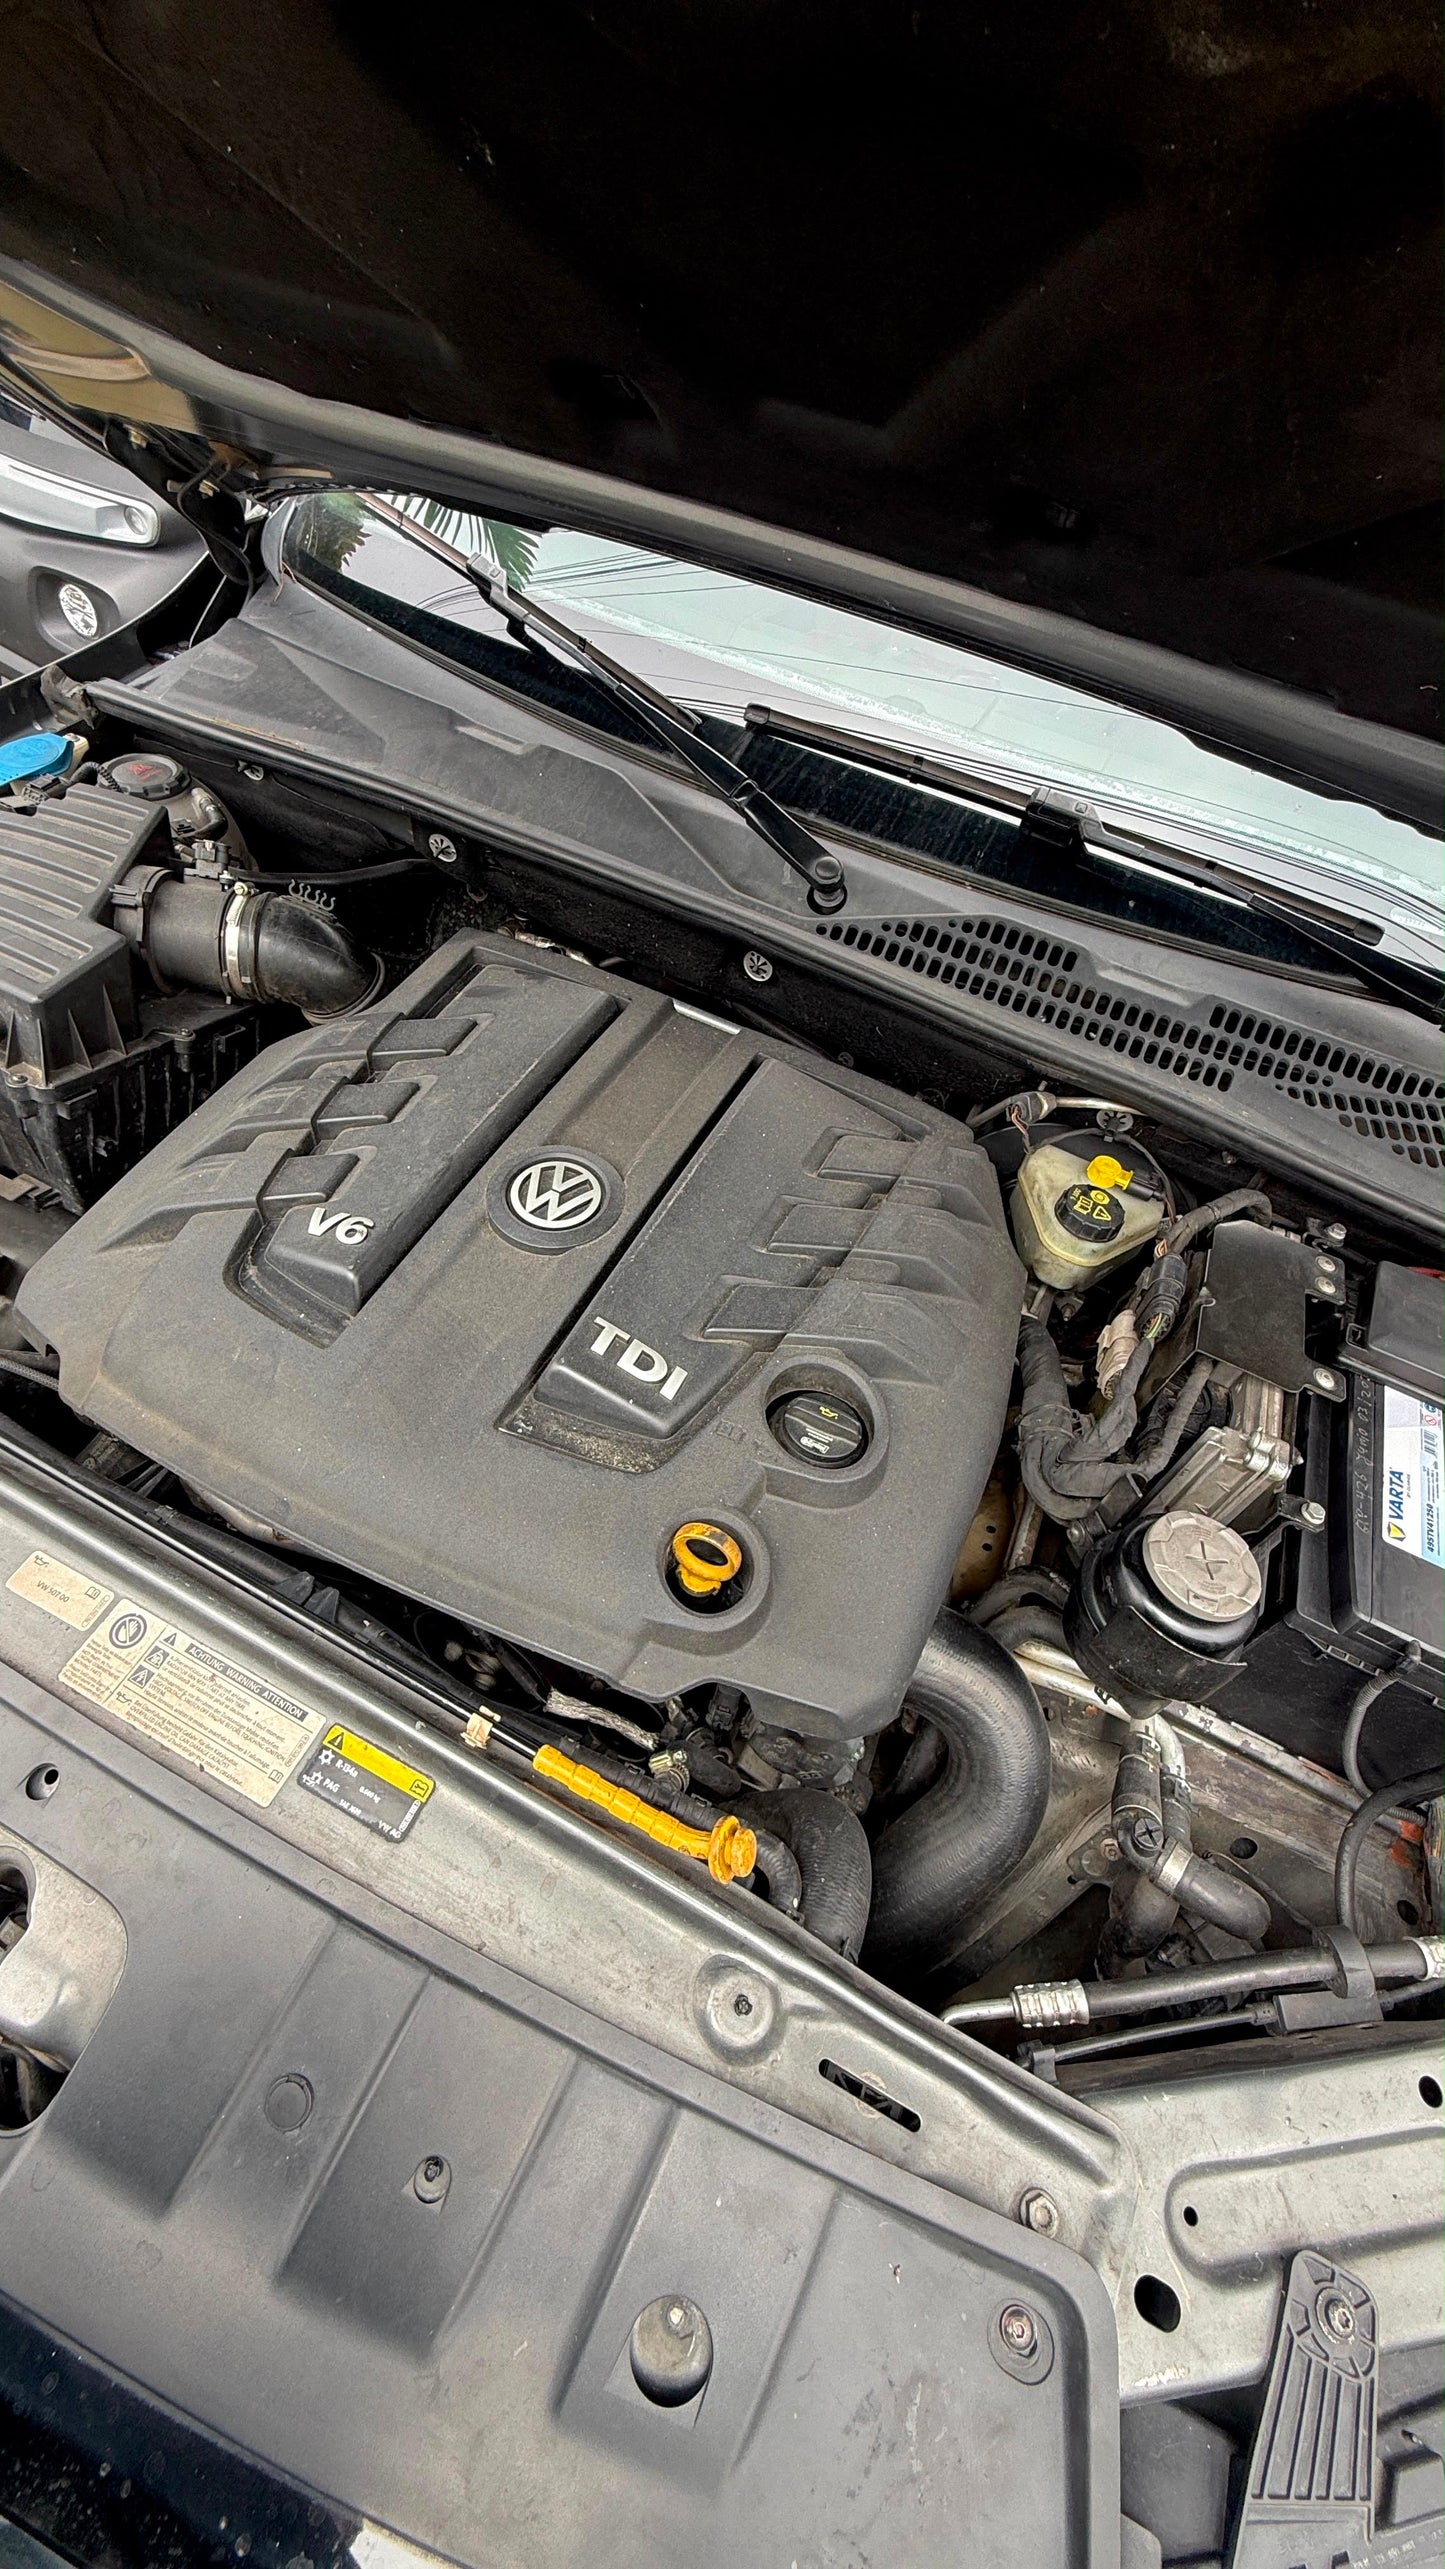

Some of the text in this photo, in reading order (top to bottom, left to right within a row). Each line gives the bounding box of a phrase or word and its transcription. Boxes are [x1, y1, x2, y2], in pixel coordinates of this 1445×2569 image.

[306, 1205, 374, 1246] V6
[592, 1315, 688, 1402] TDI
[1389, 1471, 1404, 1520] VARTA
[37, 1580, 70, 1603] VW 507 00
[188, 1645, 303, 1718] ACHTUNG WARNING ATTENTION
[335, 1760, 359, 1778] R-134a
[323, 1778, 340, 1793] PAG
[378, 1820, 402, 1839] VW AG
